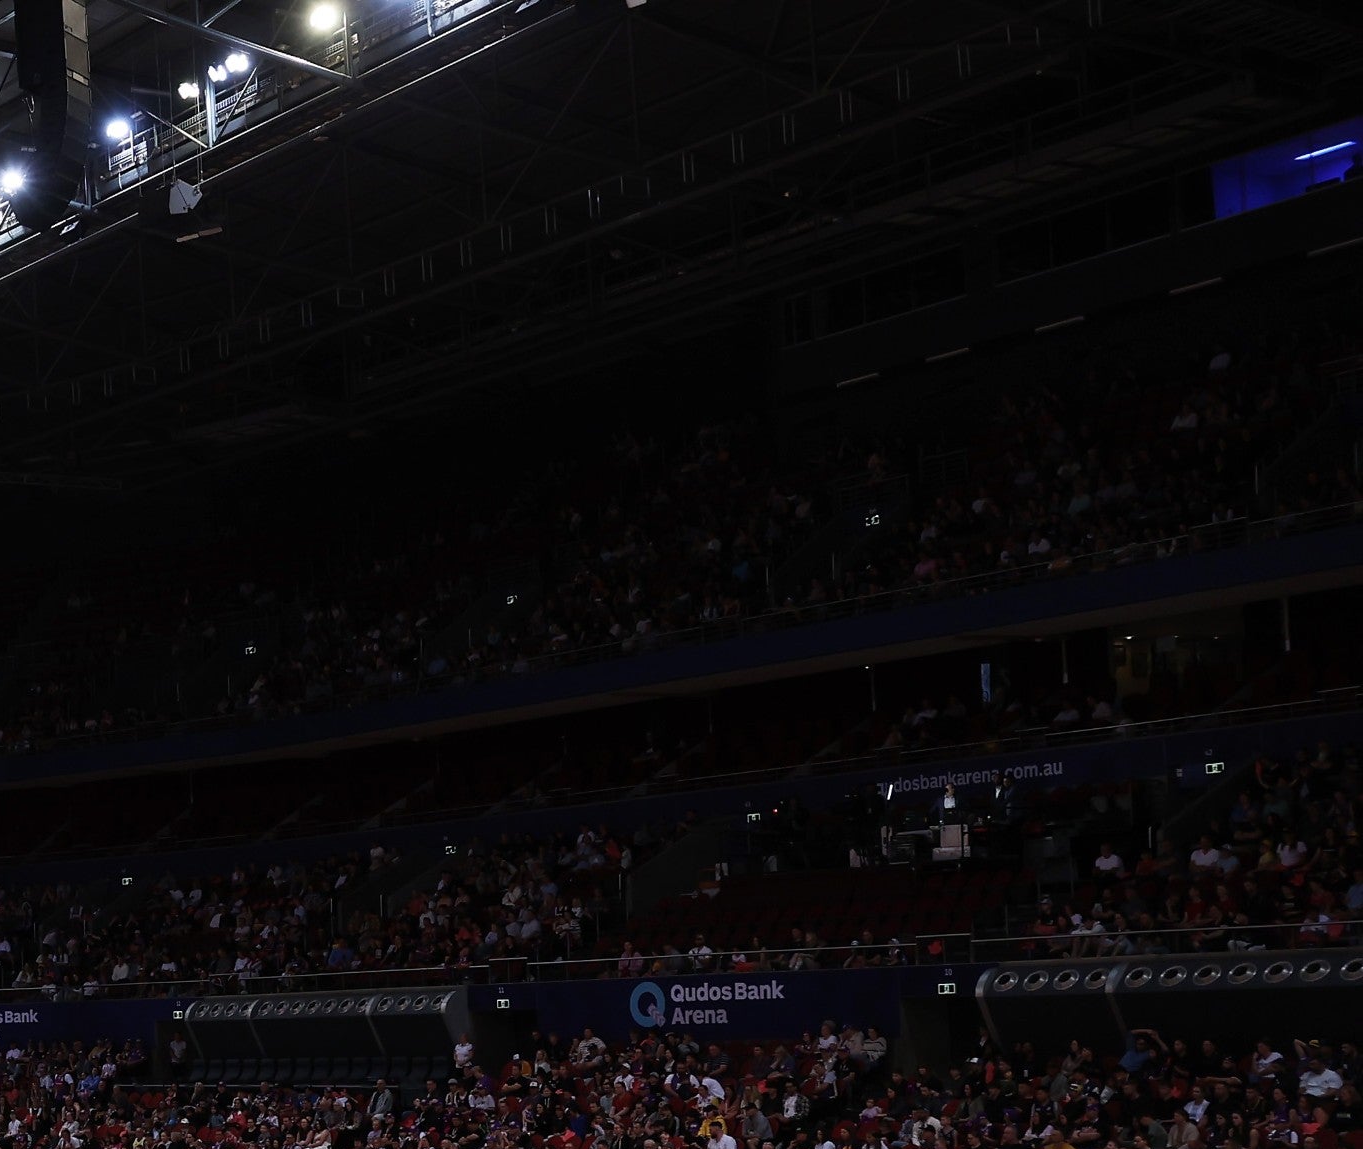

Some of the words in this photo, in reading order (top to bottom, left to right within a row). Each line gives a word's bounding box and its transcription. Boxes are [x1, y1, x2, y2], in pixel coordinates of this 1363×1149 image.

[670, 983, 733, 1002] Qudos
[734, 980, 786, 1000] Bank
[5, 1009, 39, 1024] Bank
[671, 1006, 729, 1025] Arena
